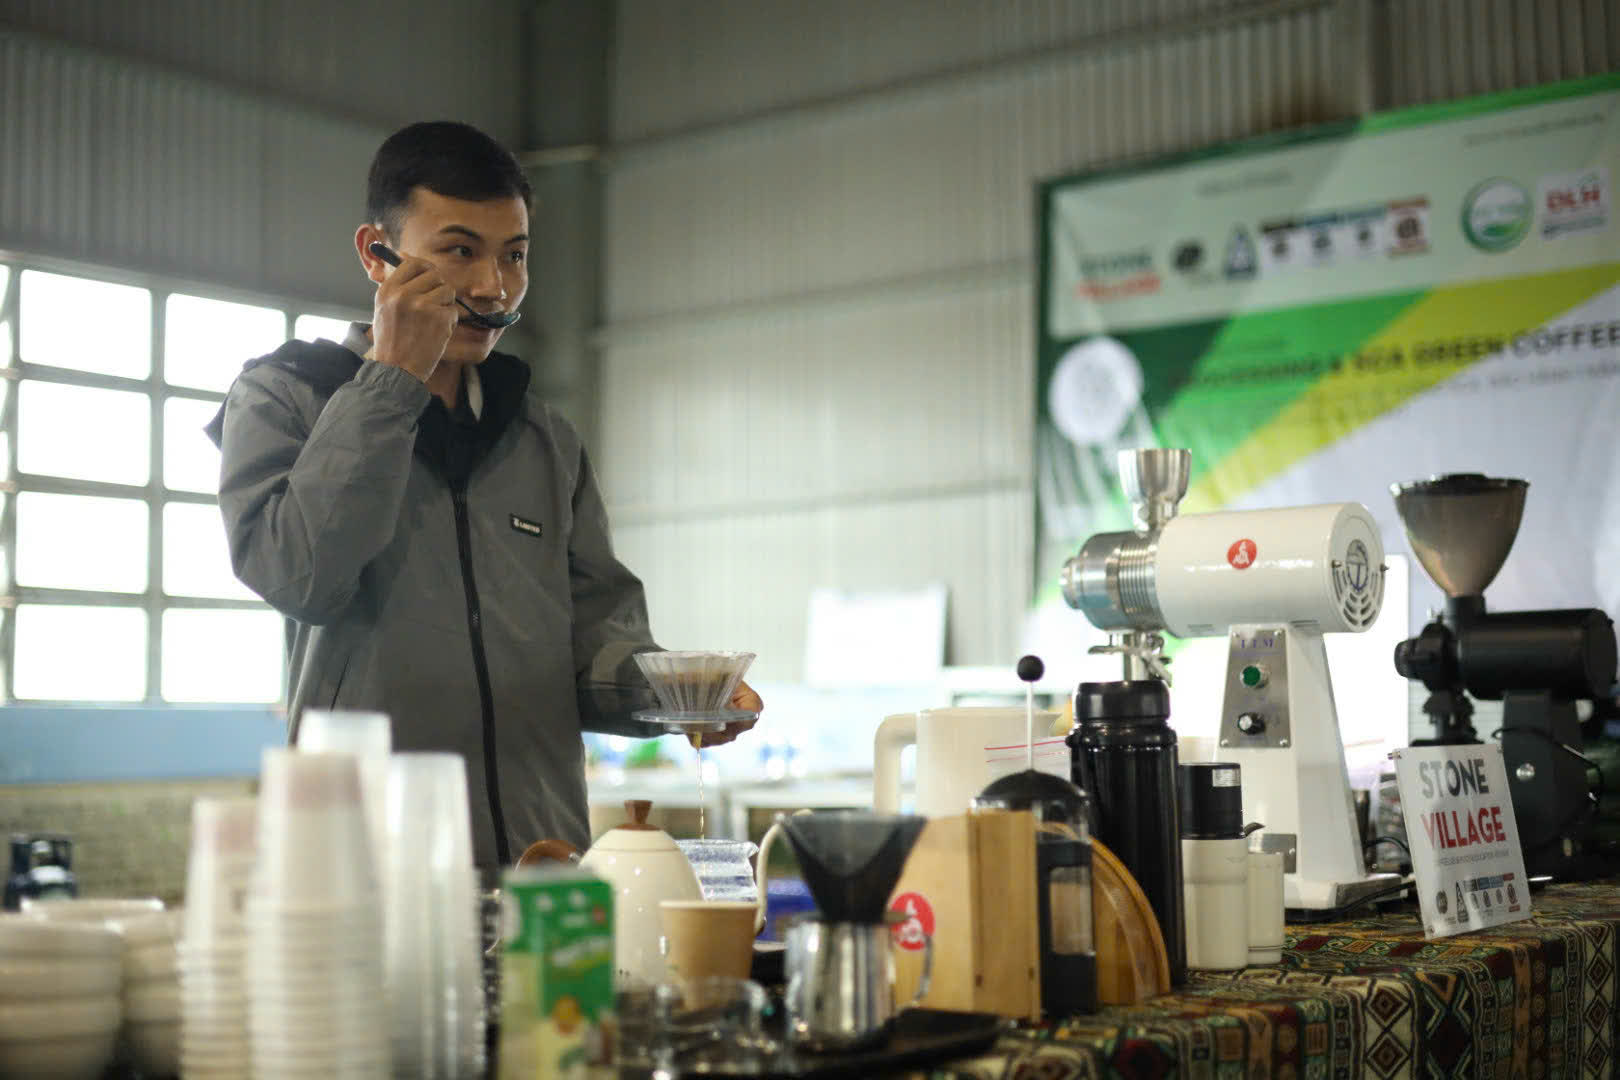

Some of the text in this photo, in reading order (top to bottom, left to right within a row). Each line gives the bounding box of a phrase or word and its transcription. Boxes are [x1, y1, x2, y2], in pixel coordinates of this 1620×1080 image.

[1511, 323, 1620, 357] COFFEE
[1418, 759, 1489, 799] STONE
[1421, 807, 1506, 848] VILLAGE
